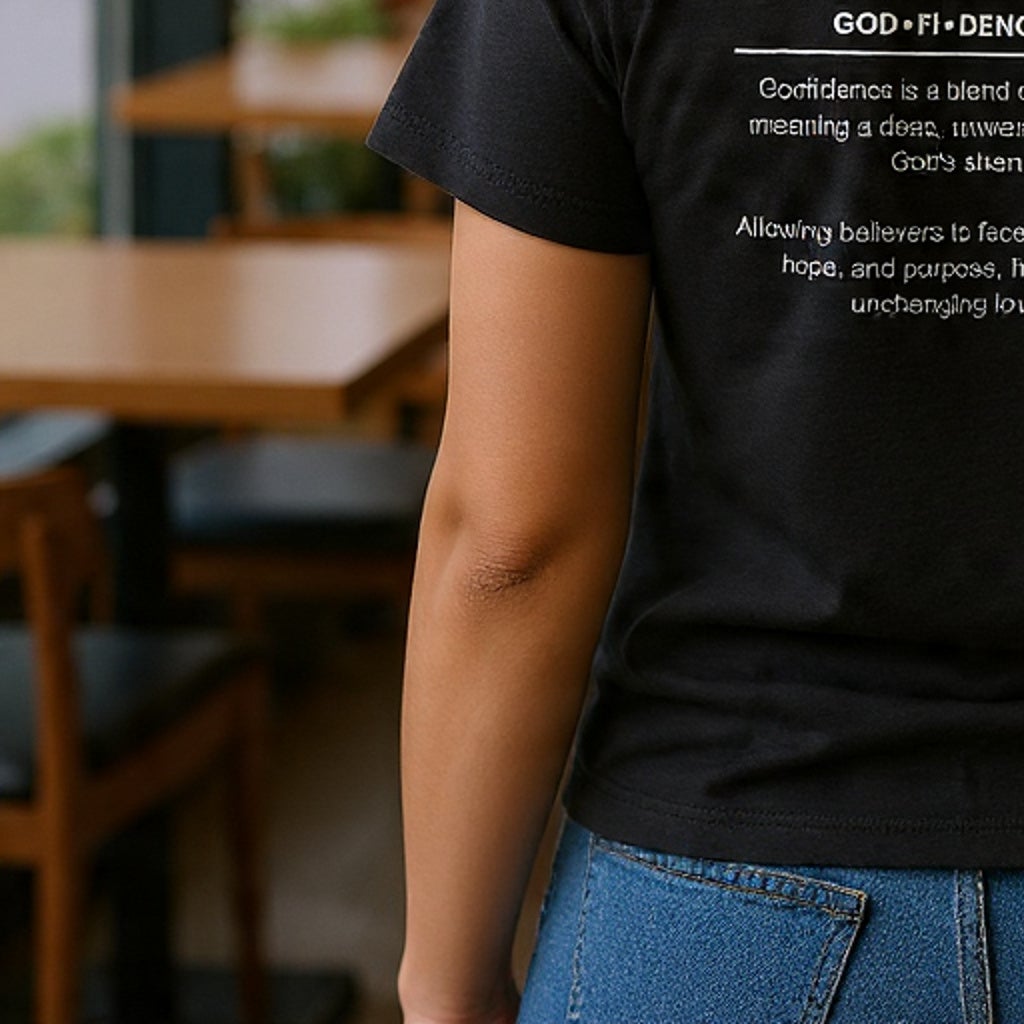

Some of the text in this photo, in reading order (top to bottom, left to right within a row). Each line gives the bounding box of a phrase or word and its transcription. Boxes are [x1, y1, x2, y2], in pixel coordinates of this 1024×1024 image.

[901, 78, 919, 101] is
[926, 83, 939, 101] a
[947, 80, 1010, 101] blend
[857, 120, 873, 138] a
[851, 257, 895, 279] and
